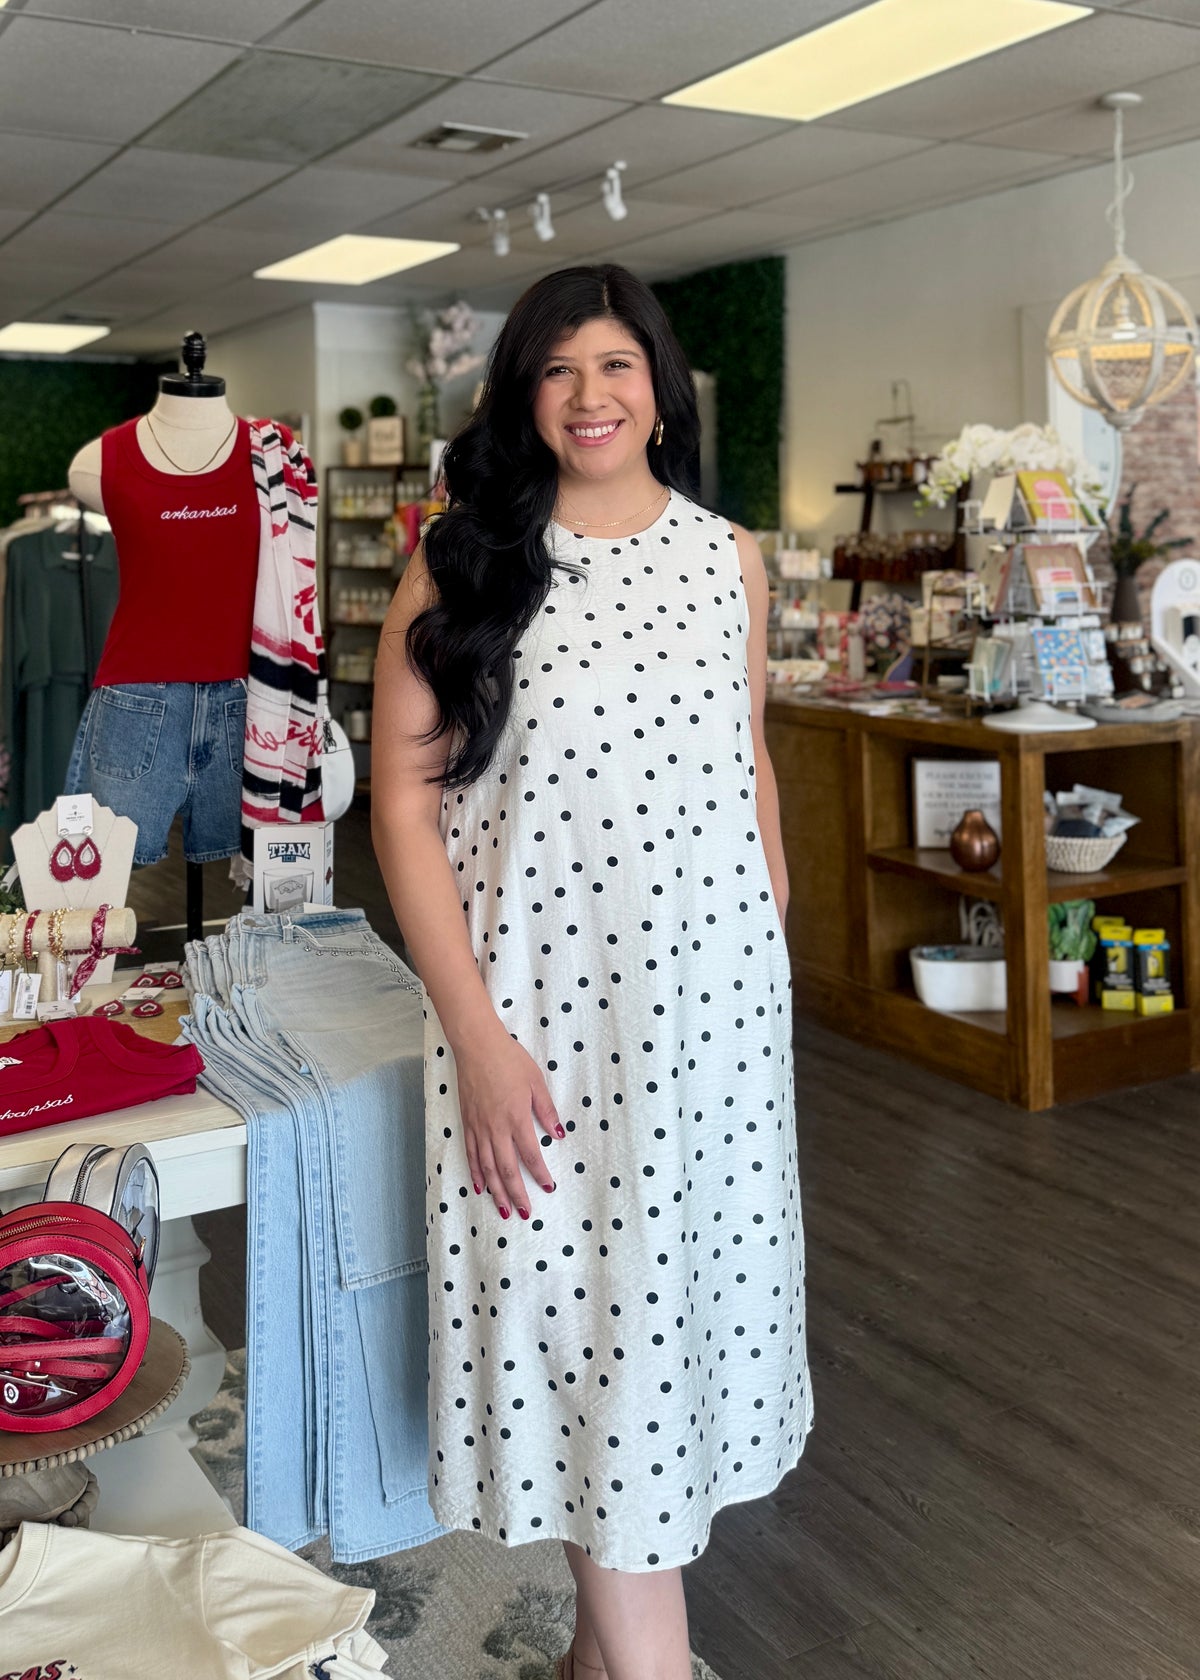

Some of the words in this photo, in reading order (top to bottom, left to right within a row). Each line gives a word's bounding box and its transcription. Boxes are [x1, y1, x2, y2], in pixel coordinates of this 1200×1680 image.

[160, 504, 238, 520] arkansas
[268, 843, 310, 860] TEAM
[0, 1094, 74, 1120] kansas
